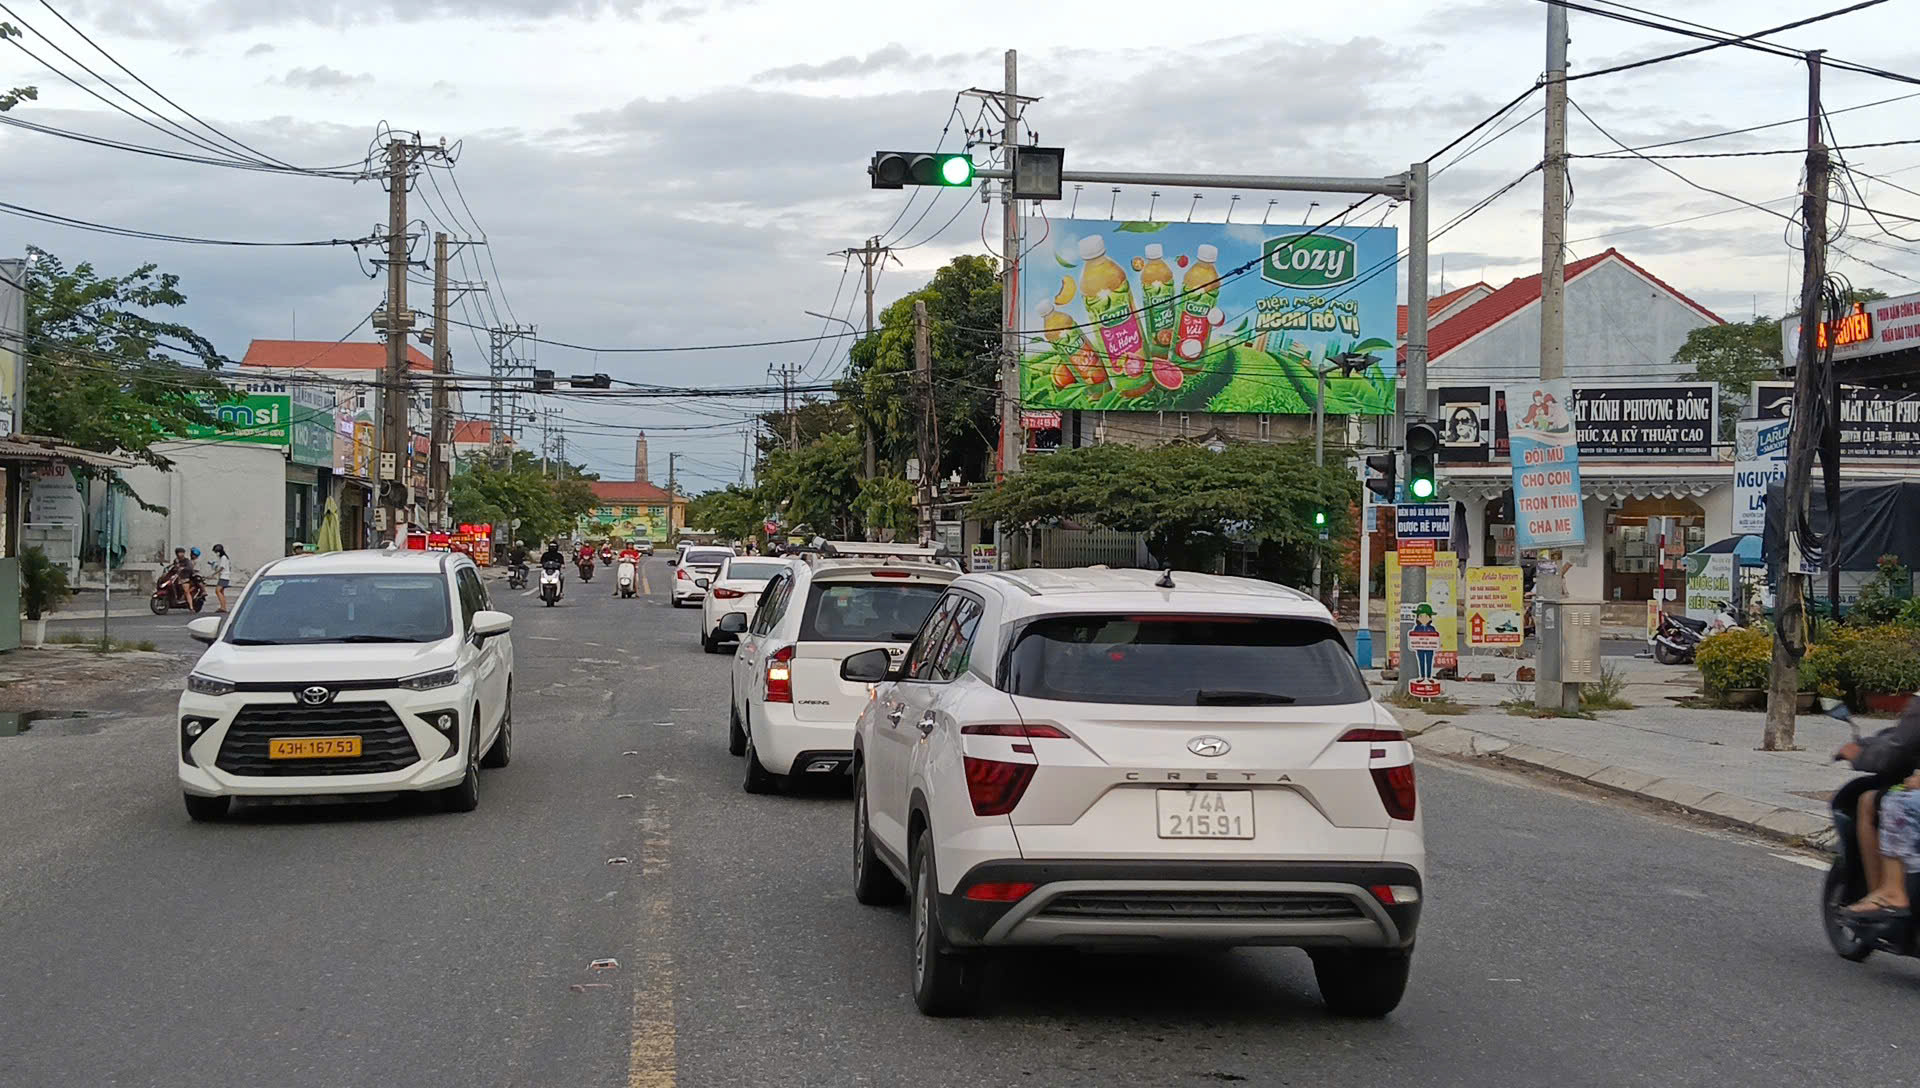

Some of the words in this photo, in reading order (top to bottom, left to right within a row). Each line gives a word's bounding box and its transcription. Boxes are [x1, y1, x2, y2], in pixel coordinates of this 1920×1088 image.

[1271, 242, 1346, 279] Cozy
[1187, 303, 1210, 316] Cozy
[1256, 312, 1308, 332] NGON
[1574, 390, 1588, 422] ẮT
[1590, 393, 1620, 422] KÍNH
[1623, 398, 1674, 422] PHƯƠNG
[1677, 391, 1709, 421] ĐÔNG
[1865, 393, 1893, 422] KÍNH
[1896, 400, 1920, 422] PHƯ
[1577, 425, 1600, 442] HÚC
[1602, 429, 1619, 446] XẠ
[1621, 425, 1639, 442] KỸ
[1641, 425, 1679, 445] THUẬT
[1681, 429, 1704, 442] CAO
[1525, 447, 1544, 467] ĐỘI
[1547, 445, 1564, 463] MŨ
[1522, 473, 1545, 488] CHO
[1547, 471, 1571, 487] CON
[1519, 497, 1548, 513] TRỌN
[1398, 521, 1419, 535] ĐƯỢC
[1420, 520, 1430, 533] RẼ
[1431, 517, 1449, 533] PHẢI
[1529, 520, 1553, 534] CHA
[1555, 518, 1572, 535] MẸ
[1125, 772, 1292, 782] CRETA
[1185, 791, 1226, 813] 74A
[1169, 815, 1242, 836] 215.91
